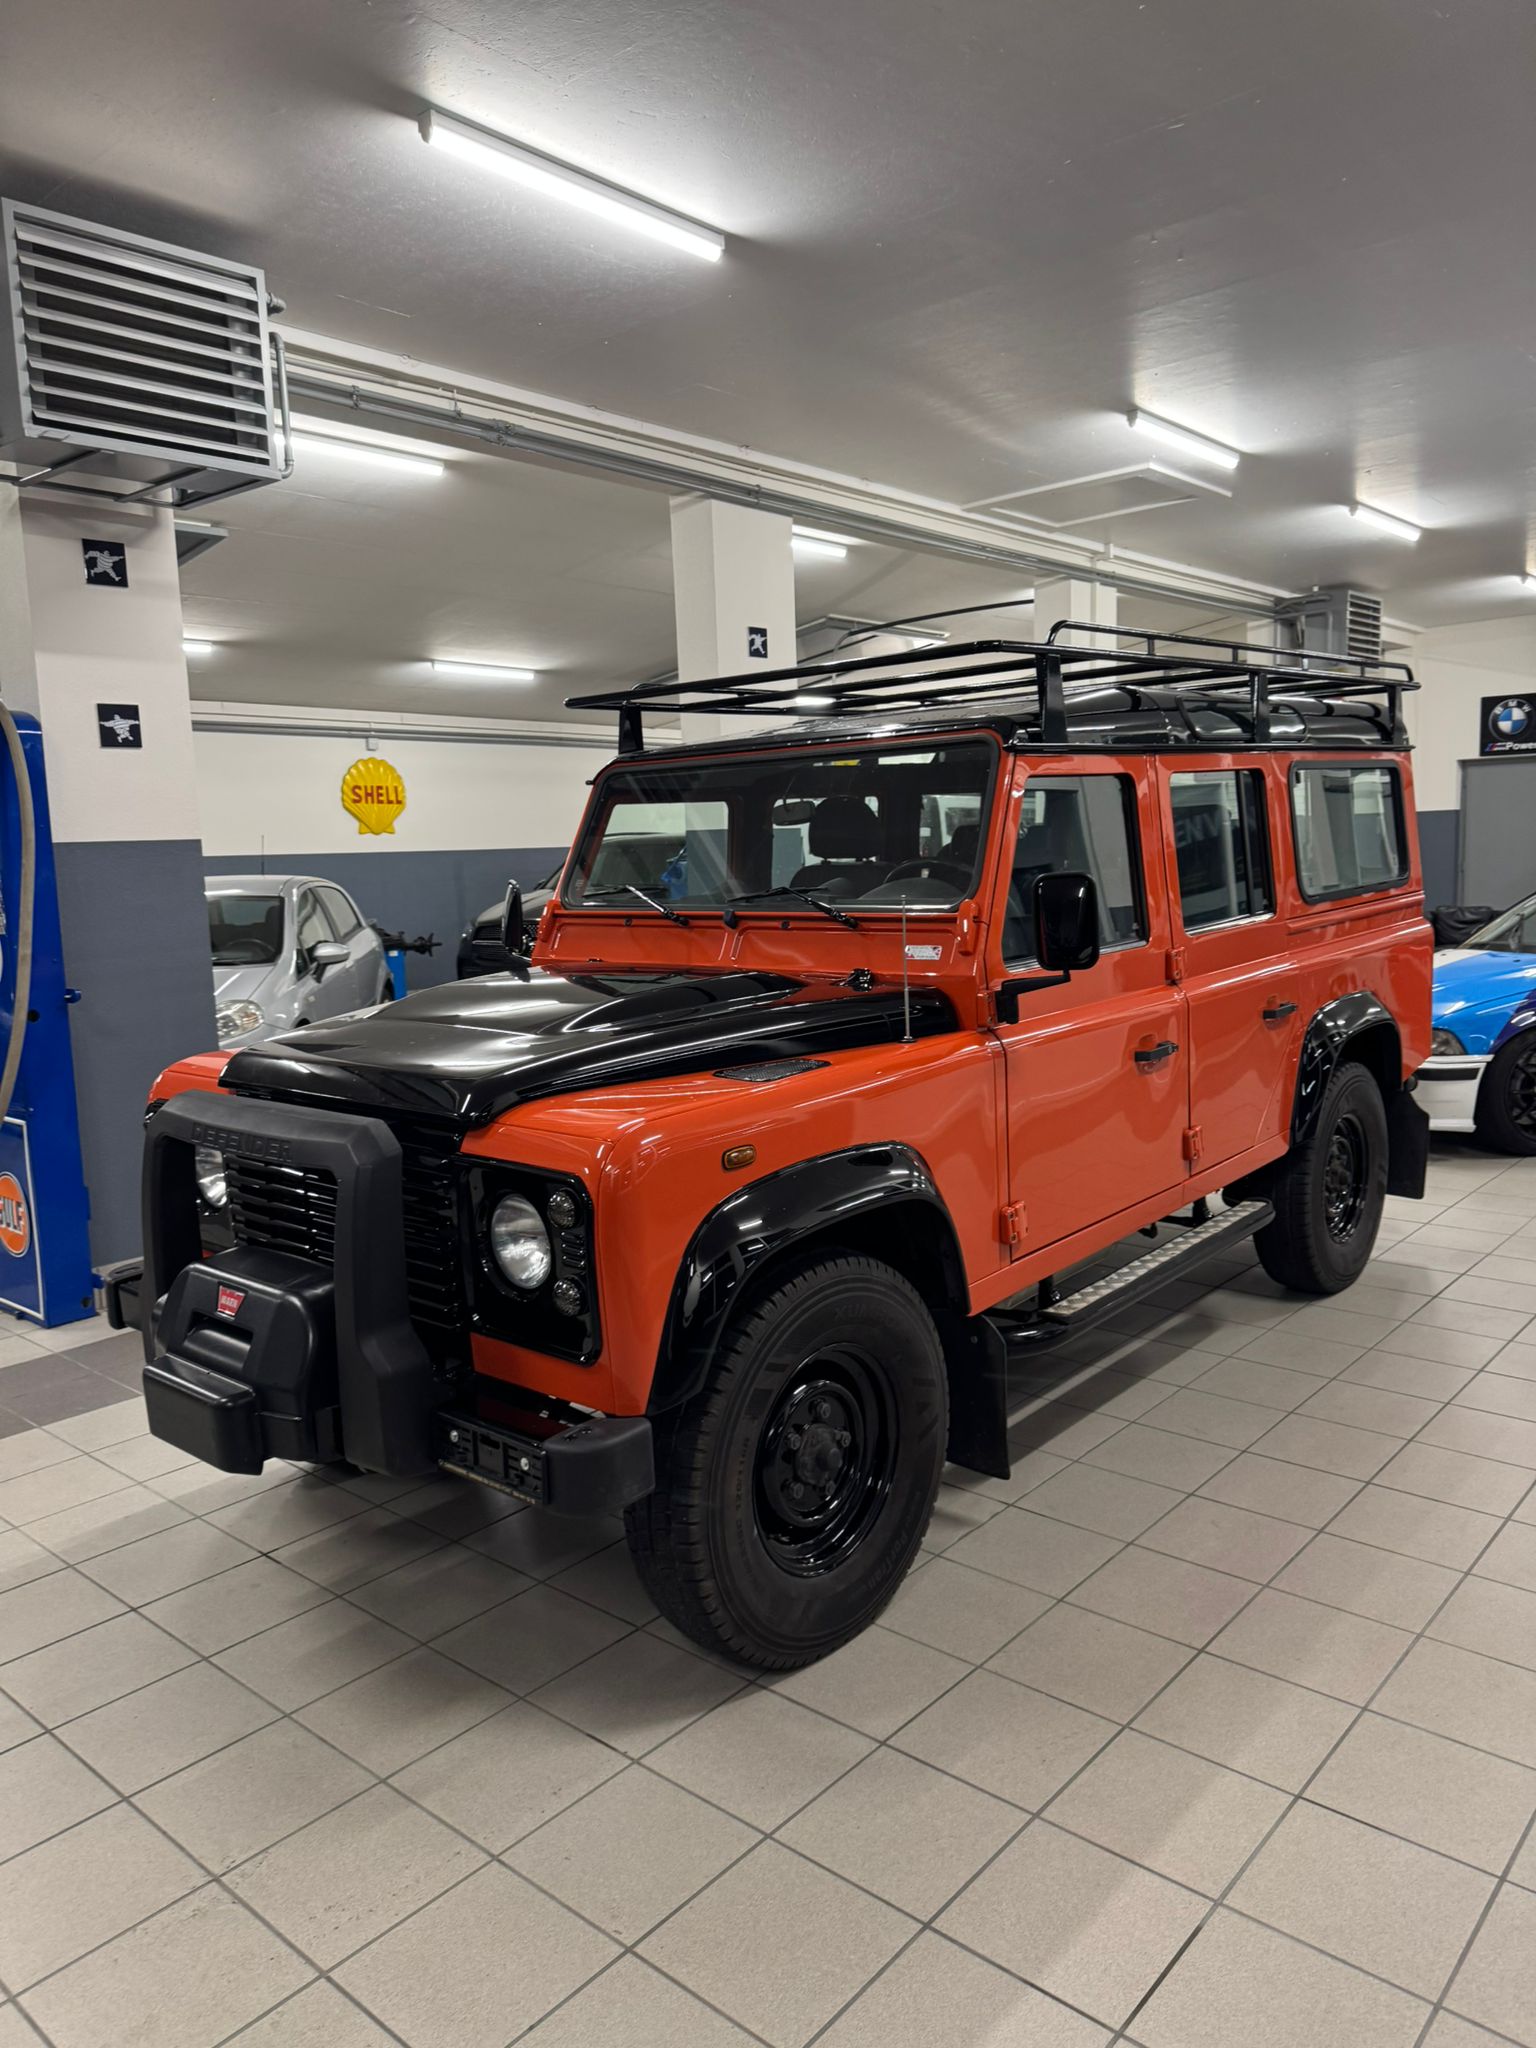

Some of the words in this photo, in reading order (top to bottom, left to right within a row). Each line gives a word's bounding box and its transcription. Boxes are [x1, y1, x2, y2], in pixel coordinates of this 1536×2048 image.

[1494, 700, 1532, 715] BMW
[351, 785, 402, 804] SHELL
[191, 1122, 293, 1162] DEFENDER
